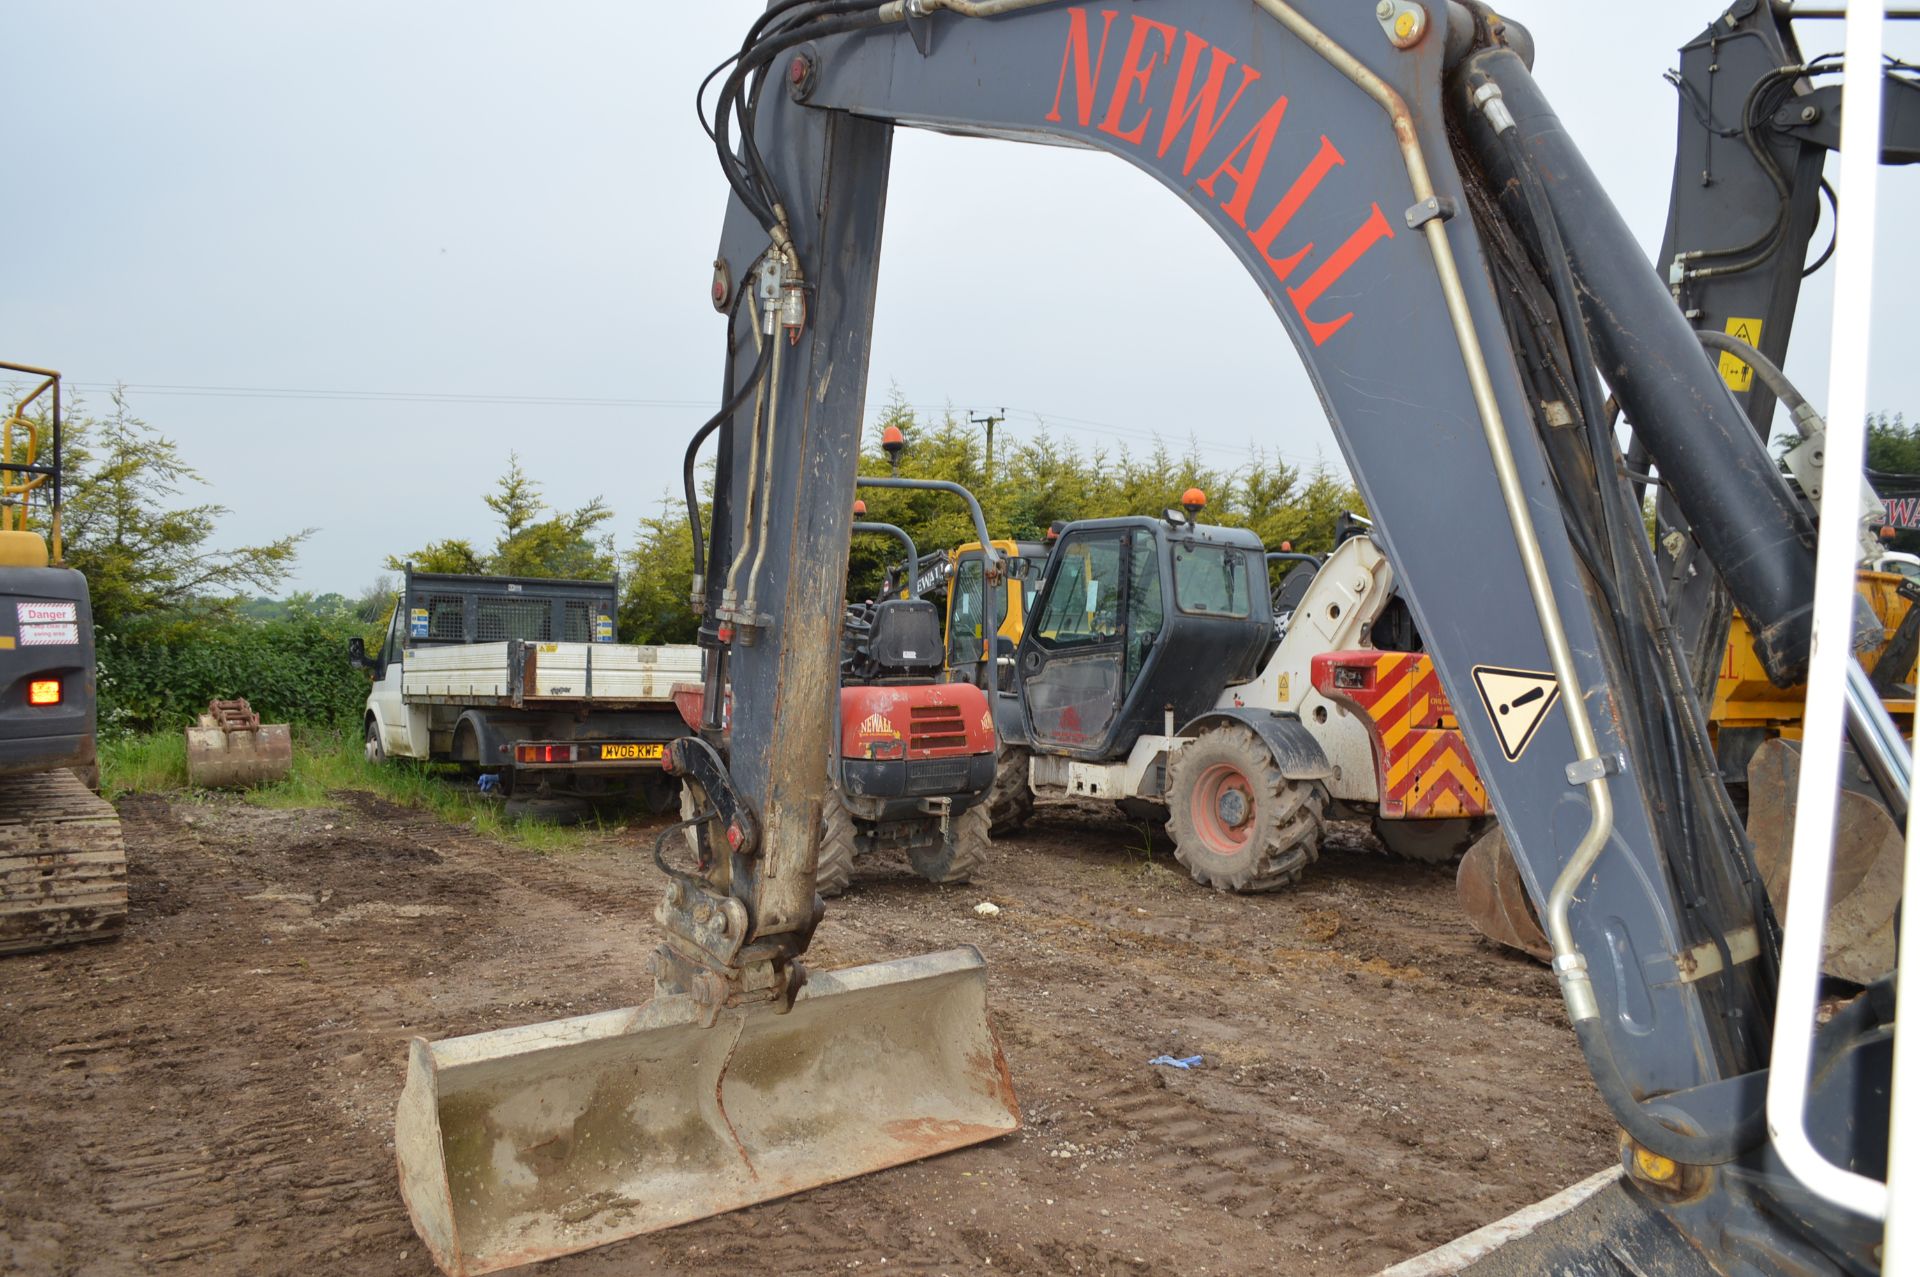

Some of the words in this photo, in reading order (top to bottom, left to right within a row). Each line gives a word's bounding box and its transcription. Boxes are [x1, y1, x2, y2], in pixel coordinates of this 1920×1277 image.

[1045, 7, 1395, 347] NEWALL
[28, 609, 66, 621] Danger
[860, 712, 893, 733] NEWALL
[637, 745, 660, 757] KWF
